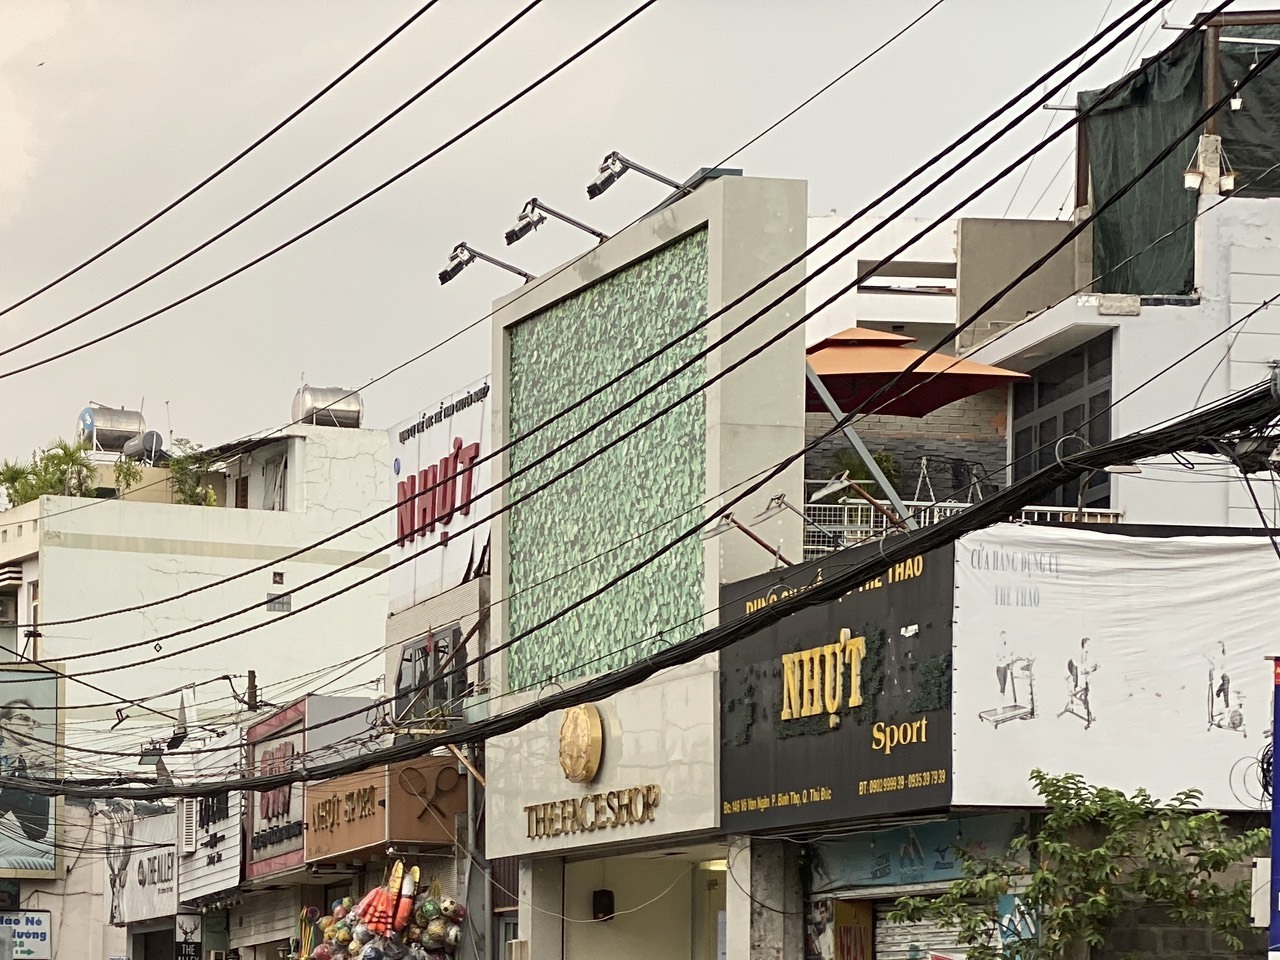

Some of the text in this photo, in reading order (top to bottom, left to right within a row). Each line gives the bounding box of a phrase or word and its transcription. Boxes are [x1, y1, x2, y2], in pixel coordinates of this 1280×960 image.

[397, 437, 480, 548] NHỰT
[781, 628, 867, 728] NHỰT
[871, 714, 929, 755] Sport
[182, 944, 195, 955] THE
